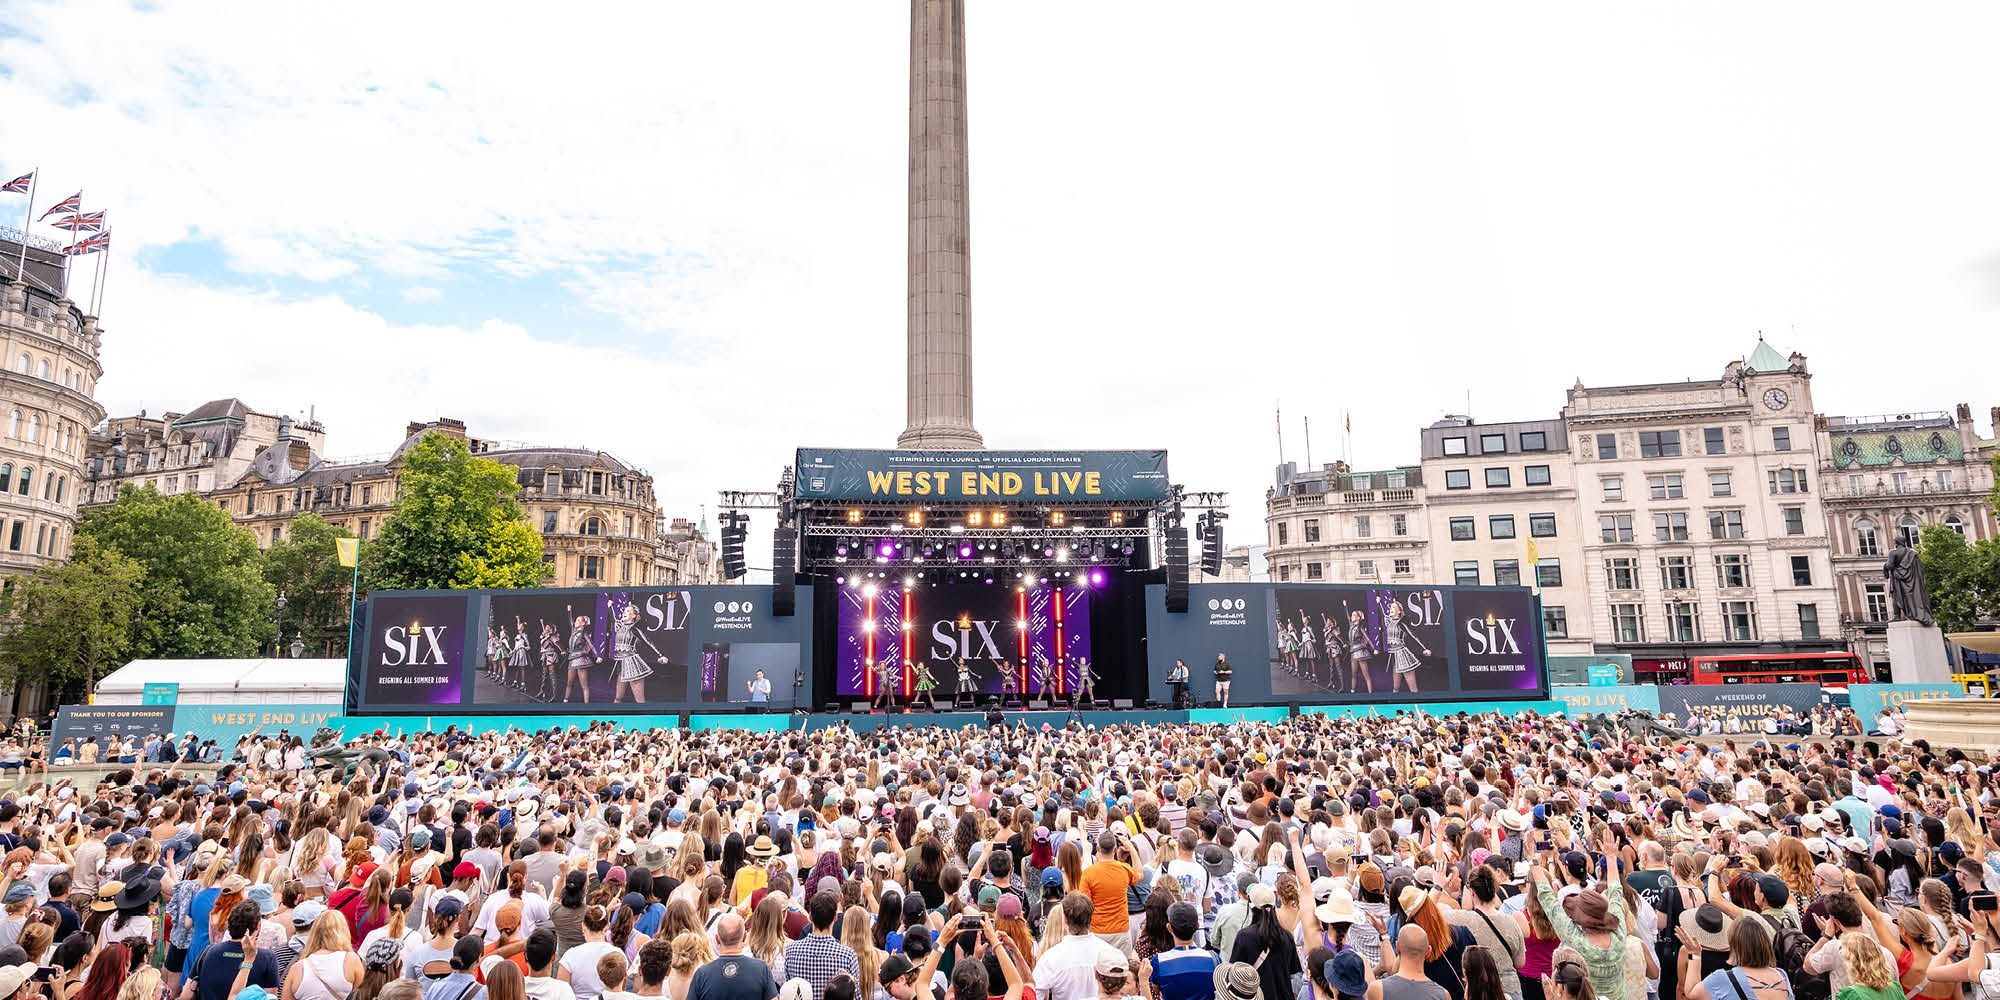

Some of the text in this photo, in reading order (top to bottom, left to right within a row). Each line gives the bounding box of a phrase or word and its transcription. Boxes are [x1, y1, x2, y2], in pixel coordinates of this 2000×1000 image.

[867, 470, 1102, 496] WEST END LIVE
[381, 625, 448, 666] SIX
[931, 619, 1004, 661] SIX
[1466, 617, 1523, 655] SIX
[435, 676, 449, 684] LONG
[1596, 693, 1626, 706] LIVE
[212, 712, 338, 725] WEST END LIV
[1730, 703, 1787, 717] MUSIC
